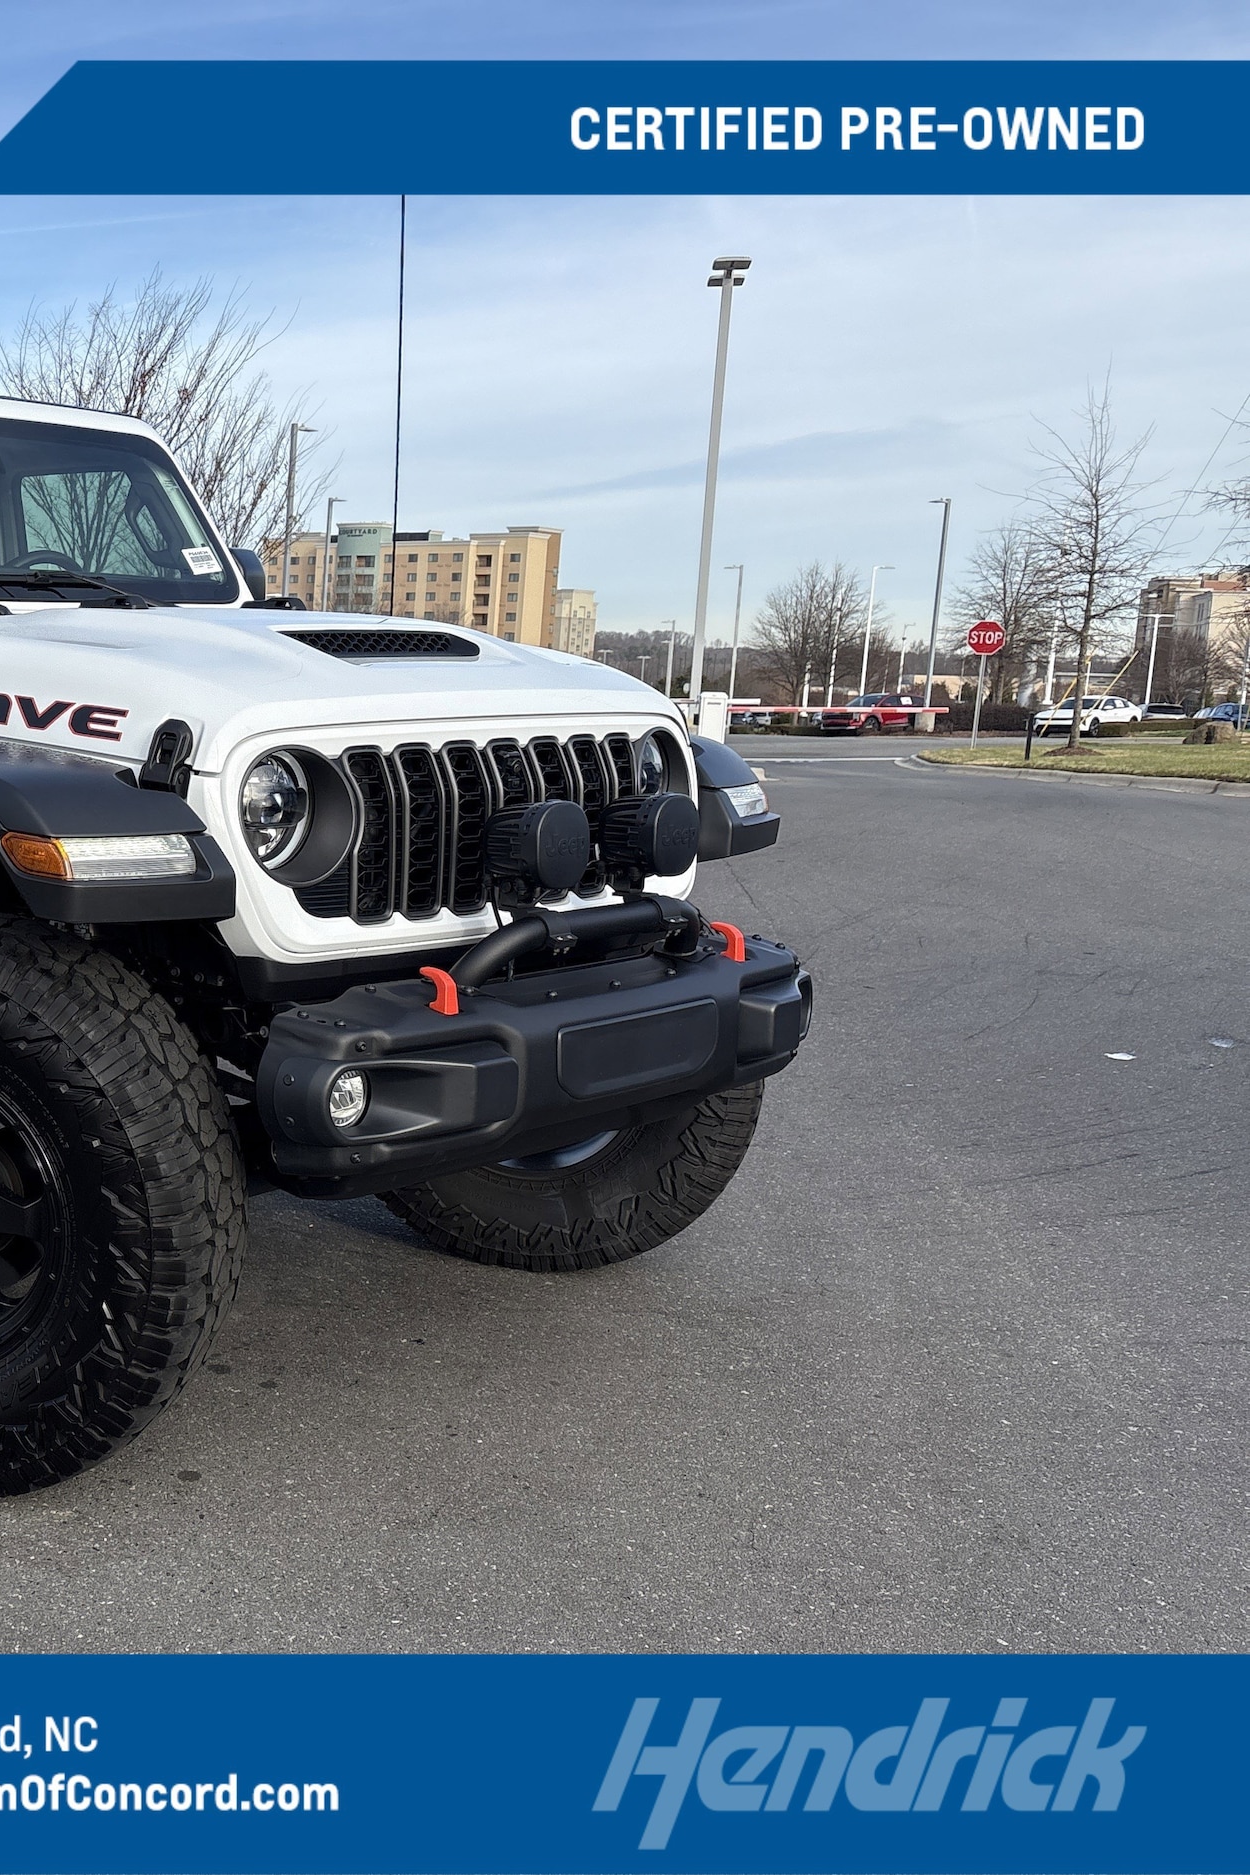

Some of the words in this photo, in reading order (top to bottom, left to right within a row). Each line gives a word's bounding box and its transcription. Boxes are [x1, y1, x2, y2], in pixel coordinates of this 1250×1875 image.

[969, 630, 1004, 645] STOP
[545, 833, 586, 859] Jeep
[661, 824, 697, 848] Jeep
